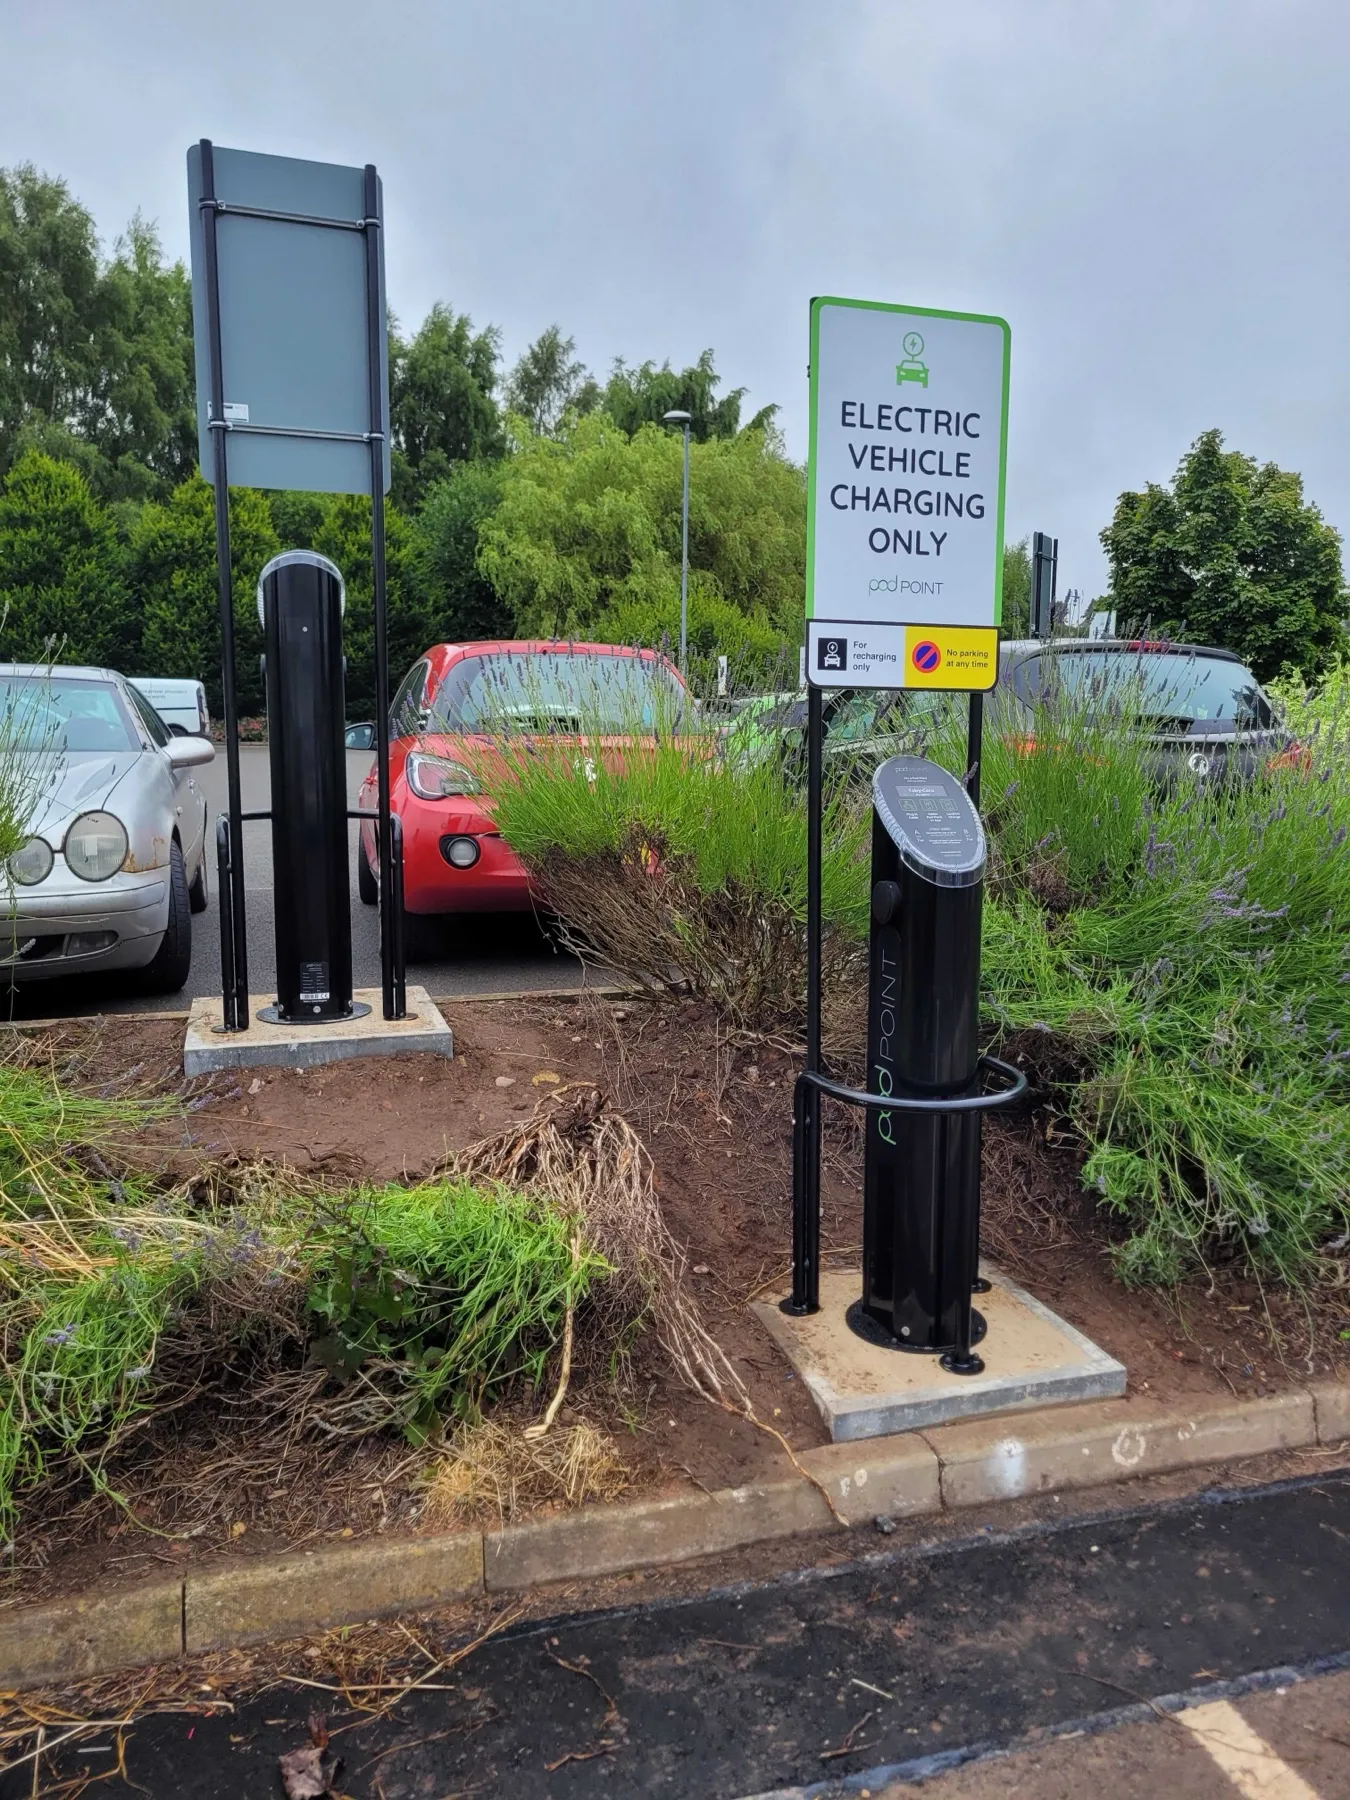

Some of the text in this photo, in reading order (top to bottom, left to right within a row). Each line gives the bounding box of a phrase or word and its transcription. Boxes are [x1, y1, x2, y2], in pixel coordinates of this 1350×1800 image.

[841, 401, 980, 438] ELECTRIC
[848, 443, 971, 478] VEHICLE
[830, 484, 985, 519] CHARGING
[868, 527, 947, 556] ONLY
[868, 575, 944, 596] pod POINT
[853, 641, 867, 649] For
[946, 649, 988, 658] No parking
[853, 652, 896, 662] recharging
[853, 663, 870, 672] only
[954, 661, 969, 669] any
[879, 949, 897, 1062] POINT
